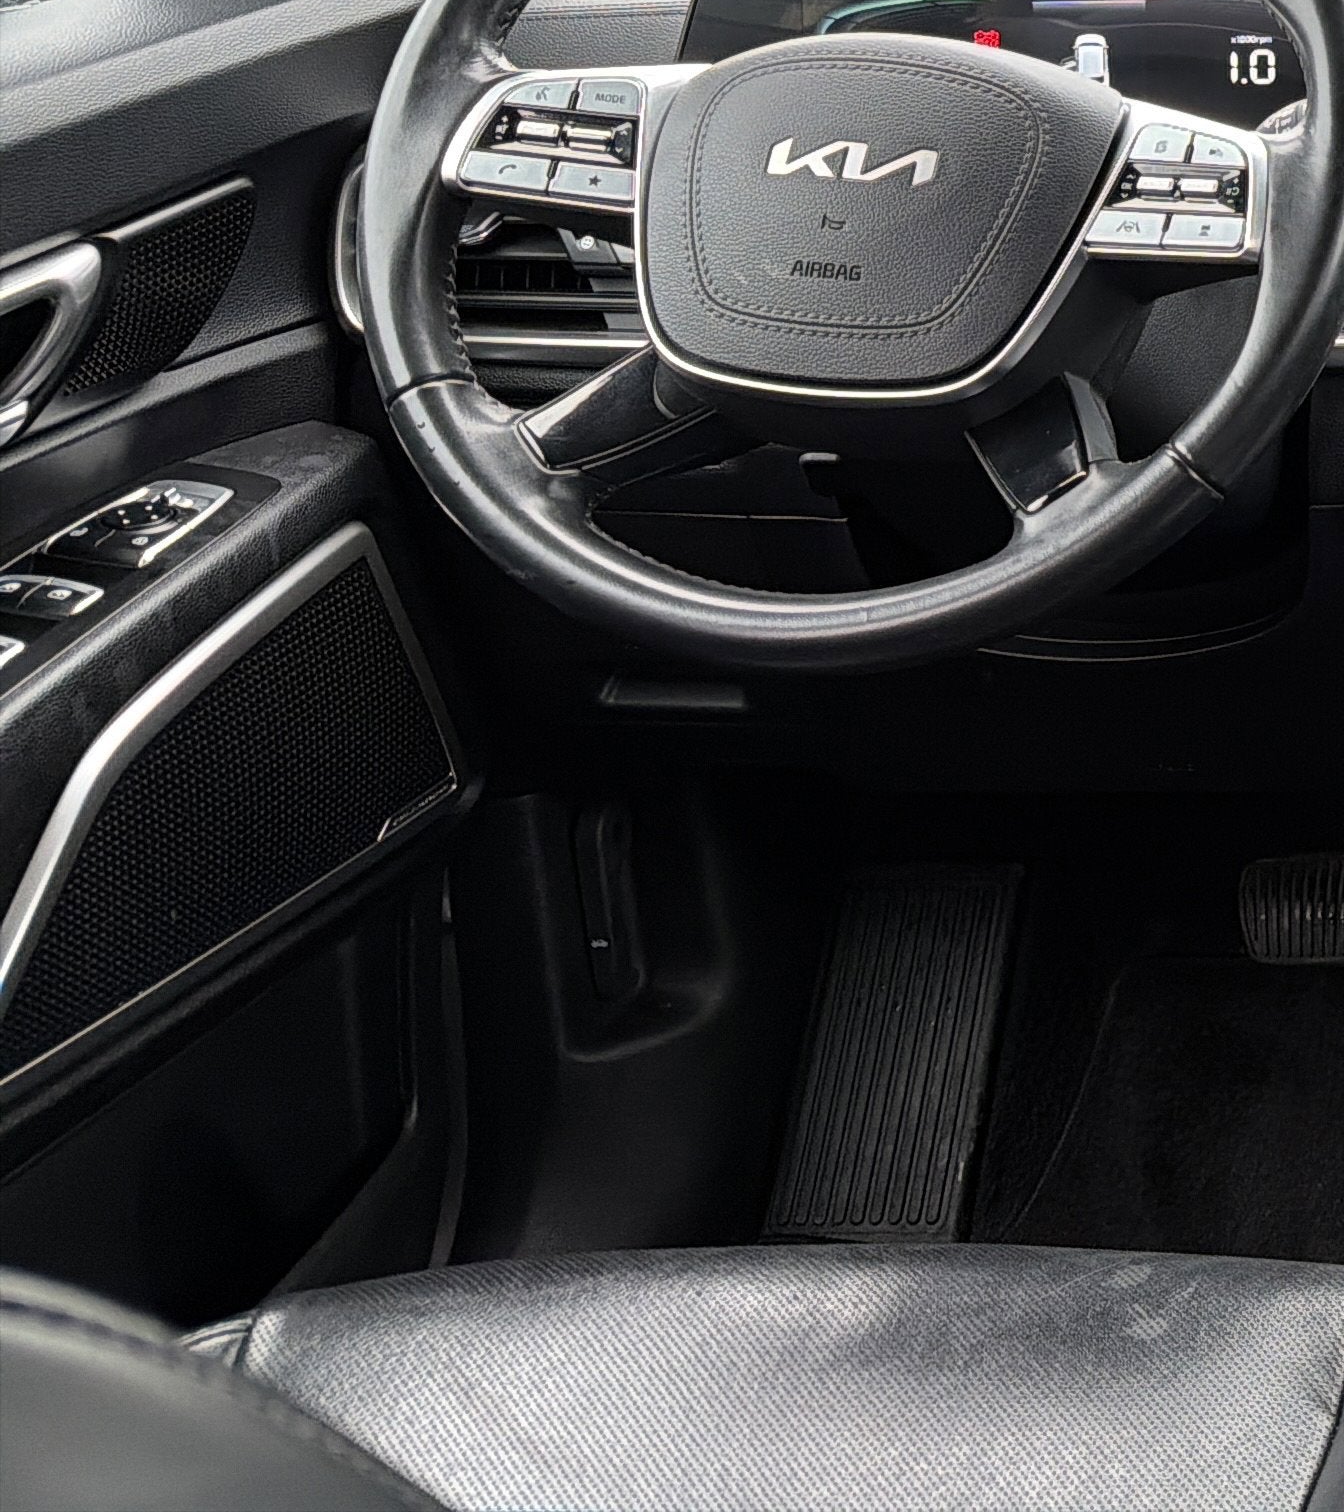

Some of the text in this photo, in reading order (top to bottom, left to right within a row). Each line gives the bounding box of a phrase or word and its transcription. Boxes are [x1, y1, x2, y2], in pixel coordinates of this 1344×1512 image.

[1229, 48, 1276, 85] 1.0
[594, 91, 626, 104] MODE
[765, 136, 939, 187] KIA
[789, 259, 863, 282] AIRBAG
